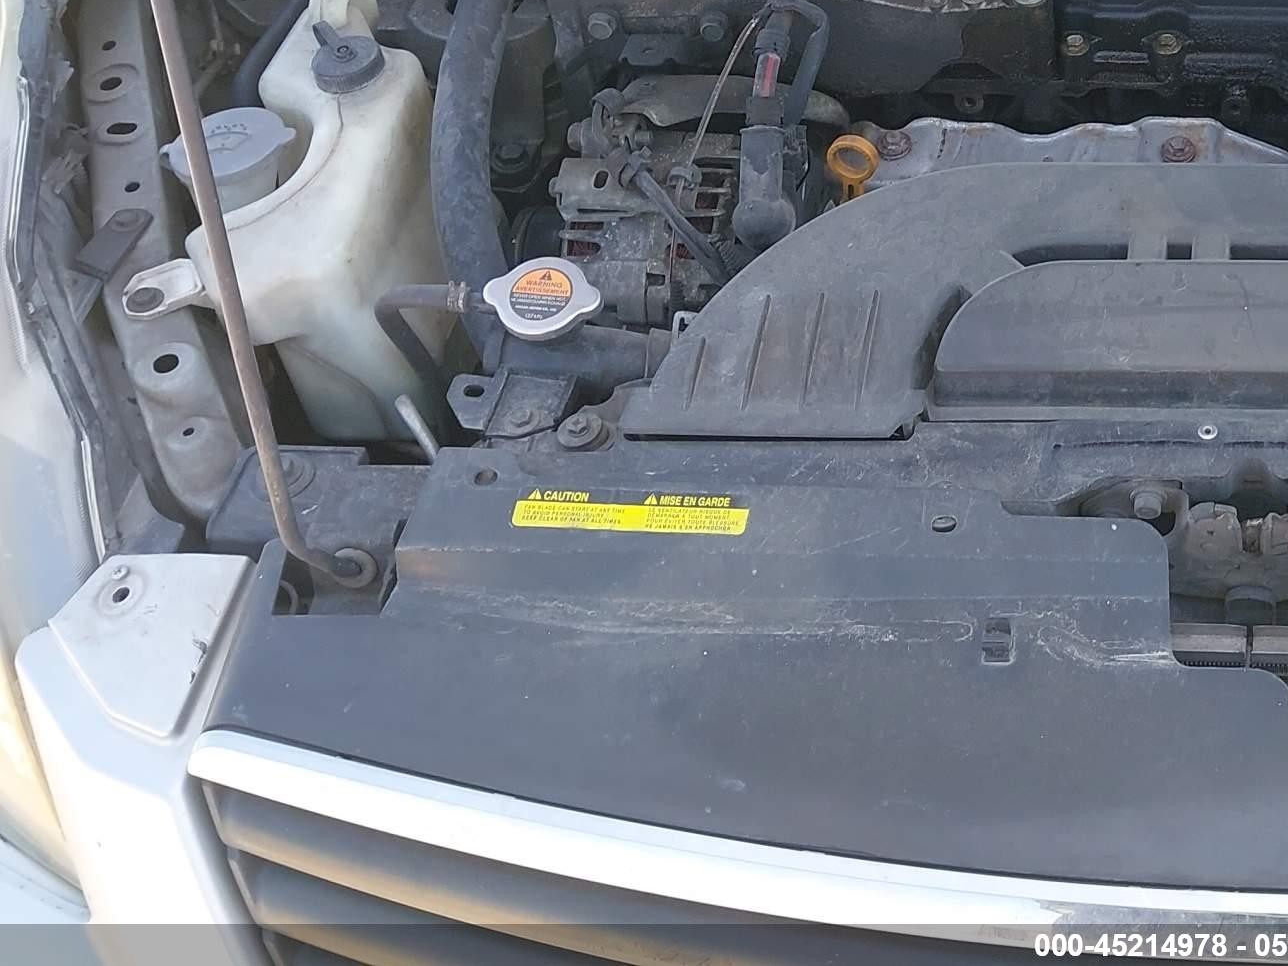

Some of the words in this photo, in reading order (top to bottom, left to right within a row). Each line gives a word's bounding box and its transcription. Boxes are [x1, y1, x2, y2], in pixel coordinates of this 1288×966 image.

[544, 491, 590, 502] CAUTION
[659, 495, 682, 505] MISE
[683, 496, 696, 506] EN
[698, 497, 731, 507] GARDE
